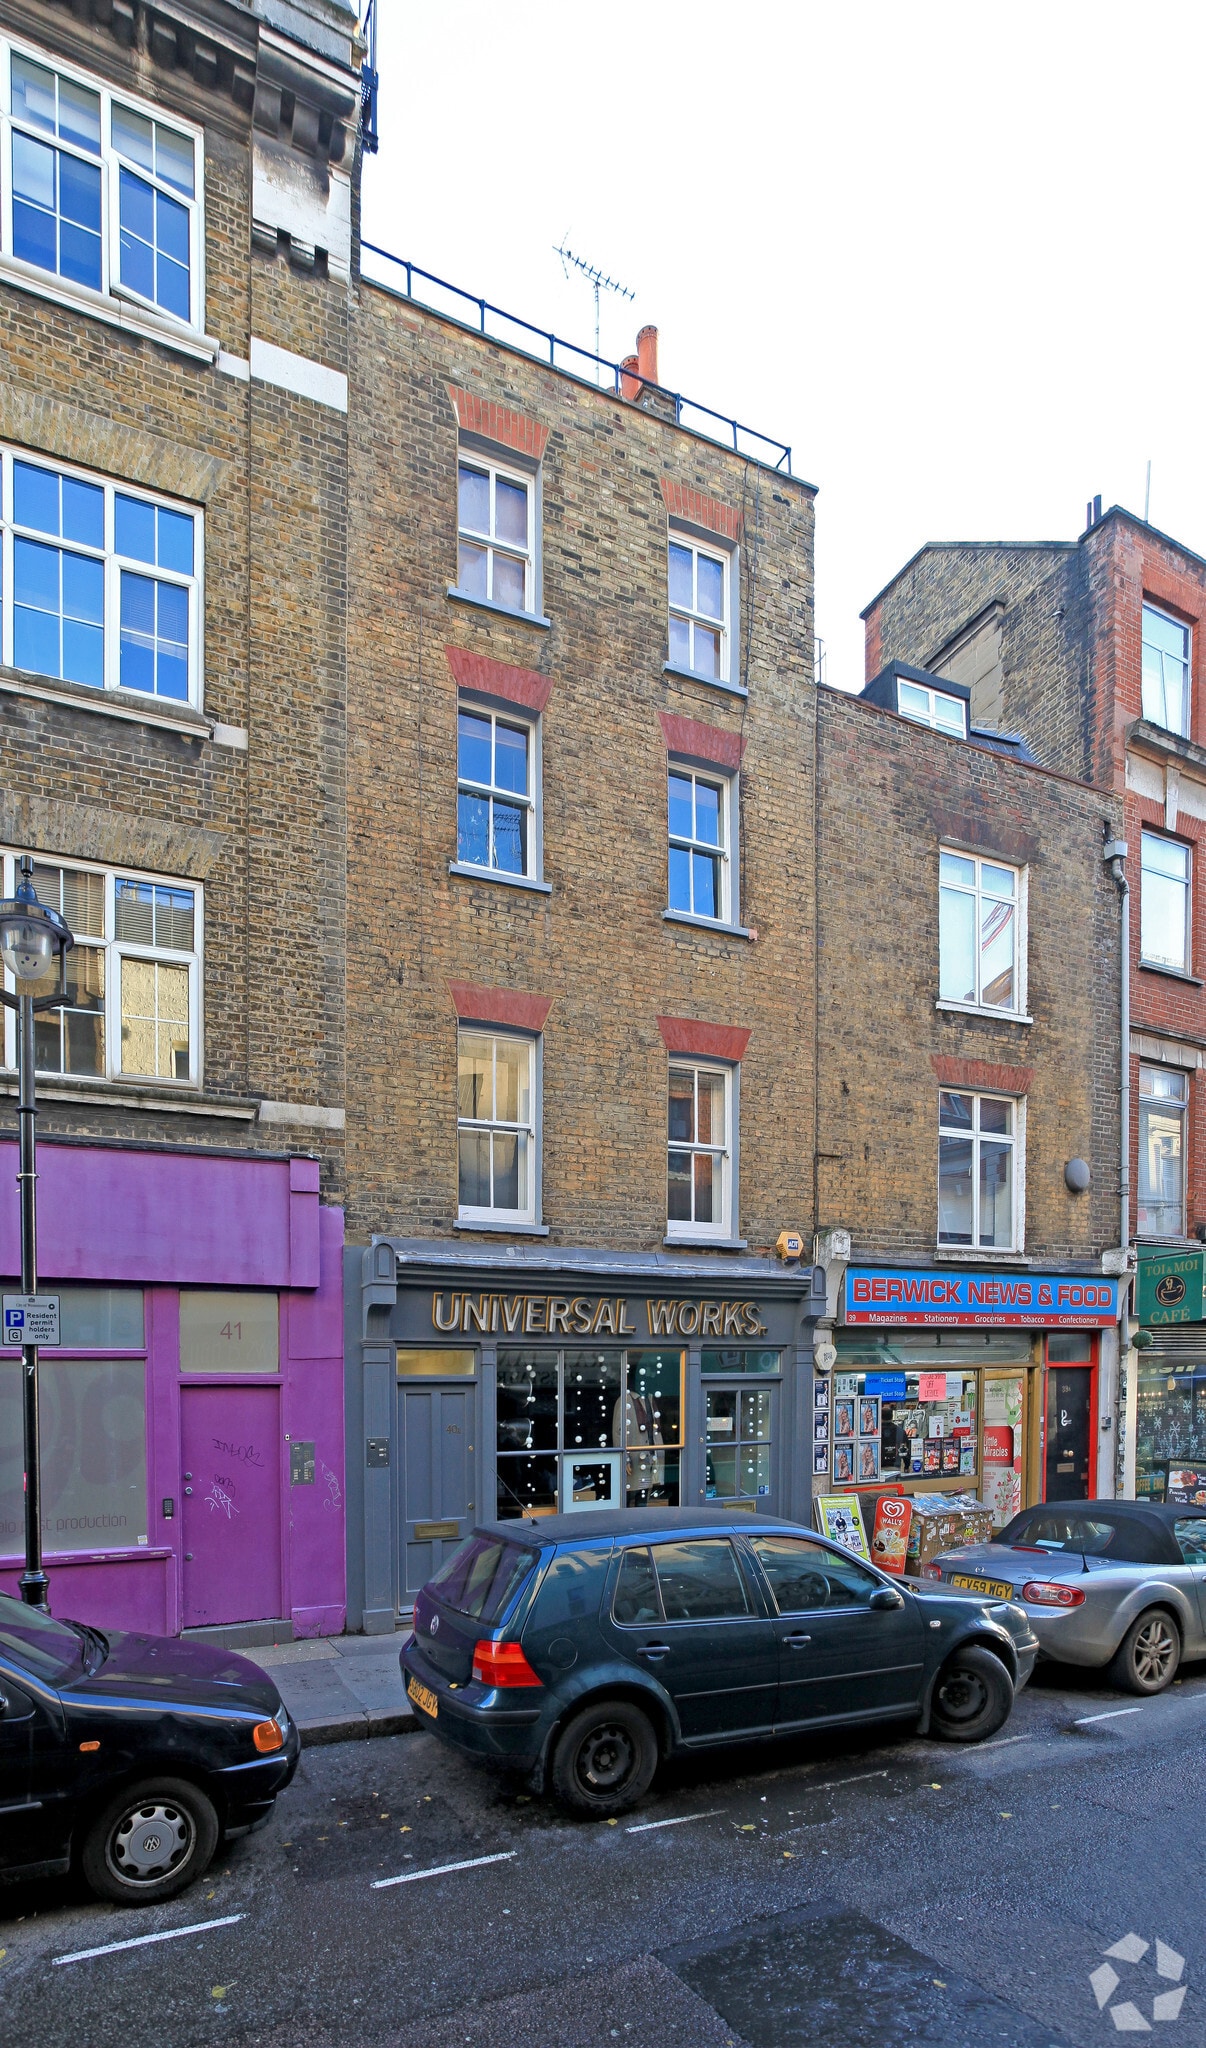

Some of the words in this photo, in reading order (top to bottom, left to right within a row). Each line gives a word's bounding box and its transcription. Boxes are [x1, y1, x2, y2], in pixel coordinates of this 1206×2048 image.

[787, 1239, 798, 1248] ADT
[1145, 1263, 1165, 1277] TOI
[1174, 1259, 1198, 1273] MOI
[853, 1278, 962, 1304] BERWICK
[968, 1281, 1032, 1306] NEWS
[1037, 1283, 1053, 1307] &
[1057, 1285, 1112, 1308] FOOD
[9, 1311, 22, 1326] P
[432, 1291, 636, 1335] UNIVERSAL
[868, 1313, 907, 1324] Magazines
[924, 1314, 960, 1325] Stationery
[974, 1314, 1006, 1323] Groceries
[1020, 1315, 1045, 1323] Tobacco
[1058, 1315, 1099, 1326] Confectionery
[1150, 1305, 1191, 1324] CAFÉ
[219, 1320, 242, 1340] 41
[26, 1366, 35, 1376] 7
[984, 1435, 998, 1447] Little
[984, 1446, 1009, 1457] Miracles
[56, 1513, 127, 1533] production
[882, 1516, 903, 1526] WALL'S
[988, 1584, 1011, 1598] WGY
